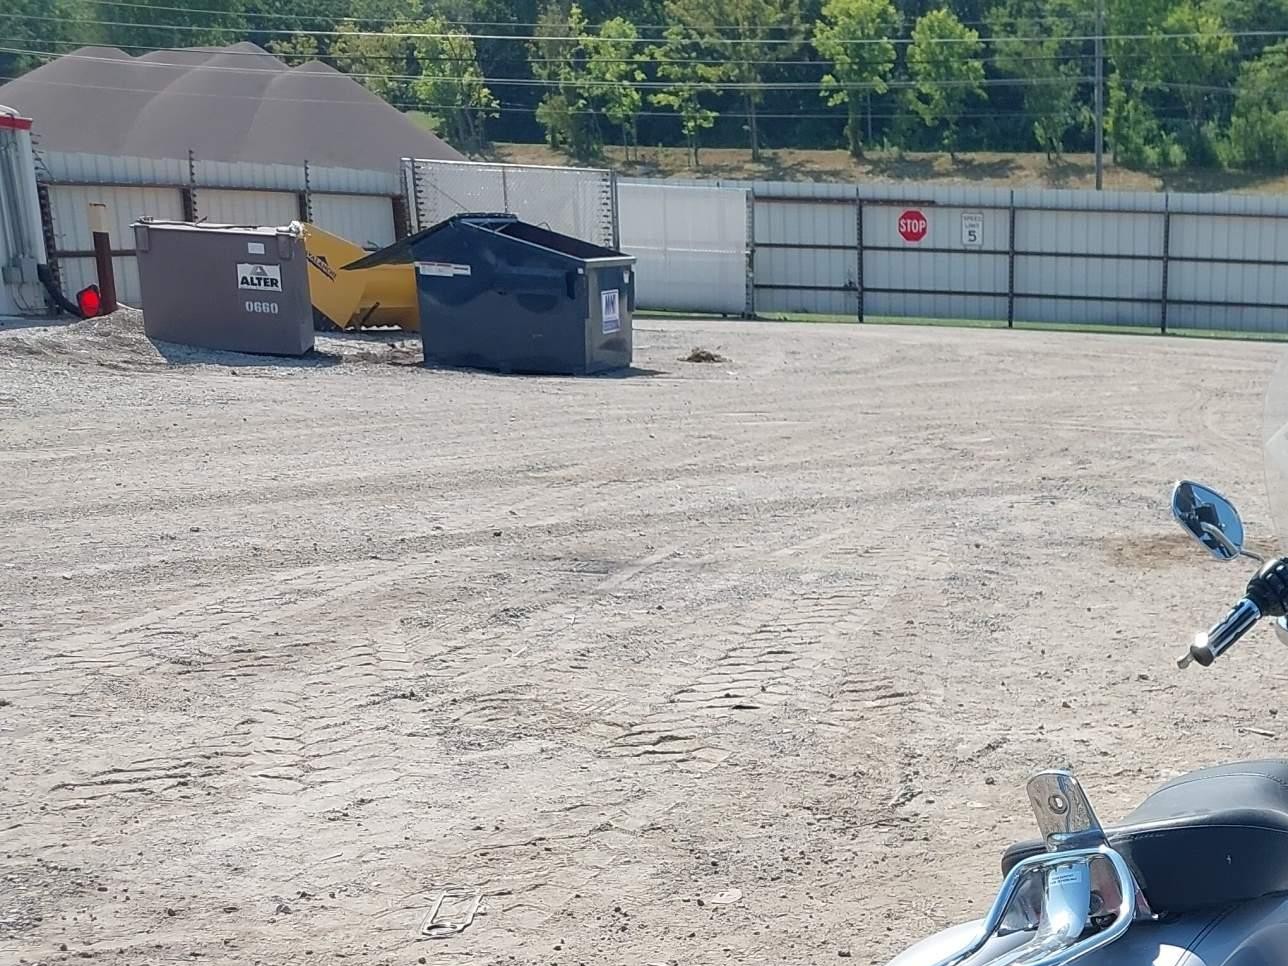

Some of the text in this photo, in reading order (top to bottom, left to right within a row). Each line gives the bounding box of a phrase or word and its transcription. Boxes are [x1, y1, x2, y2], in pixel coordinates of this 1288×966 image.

[899, 218, 926, 233] STOP
[967, 230, 977, 242] 5
[240, 275, 279, 288] ALTER
[245, 301, 279, 314] 0660
